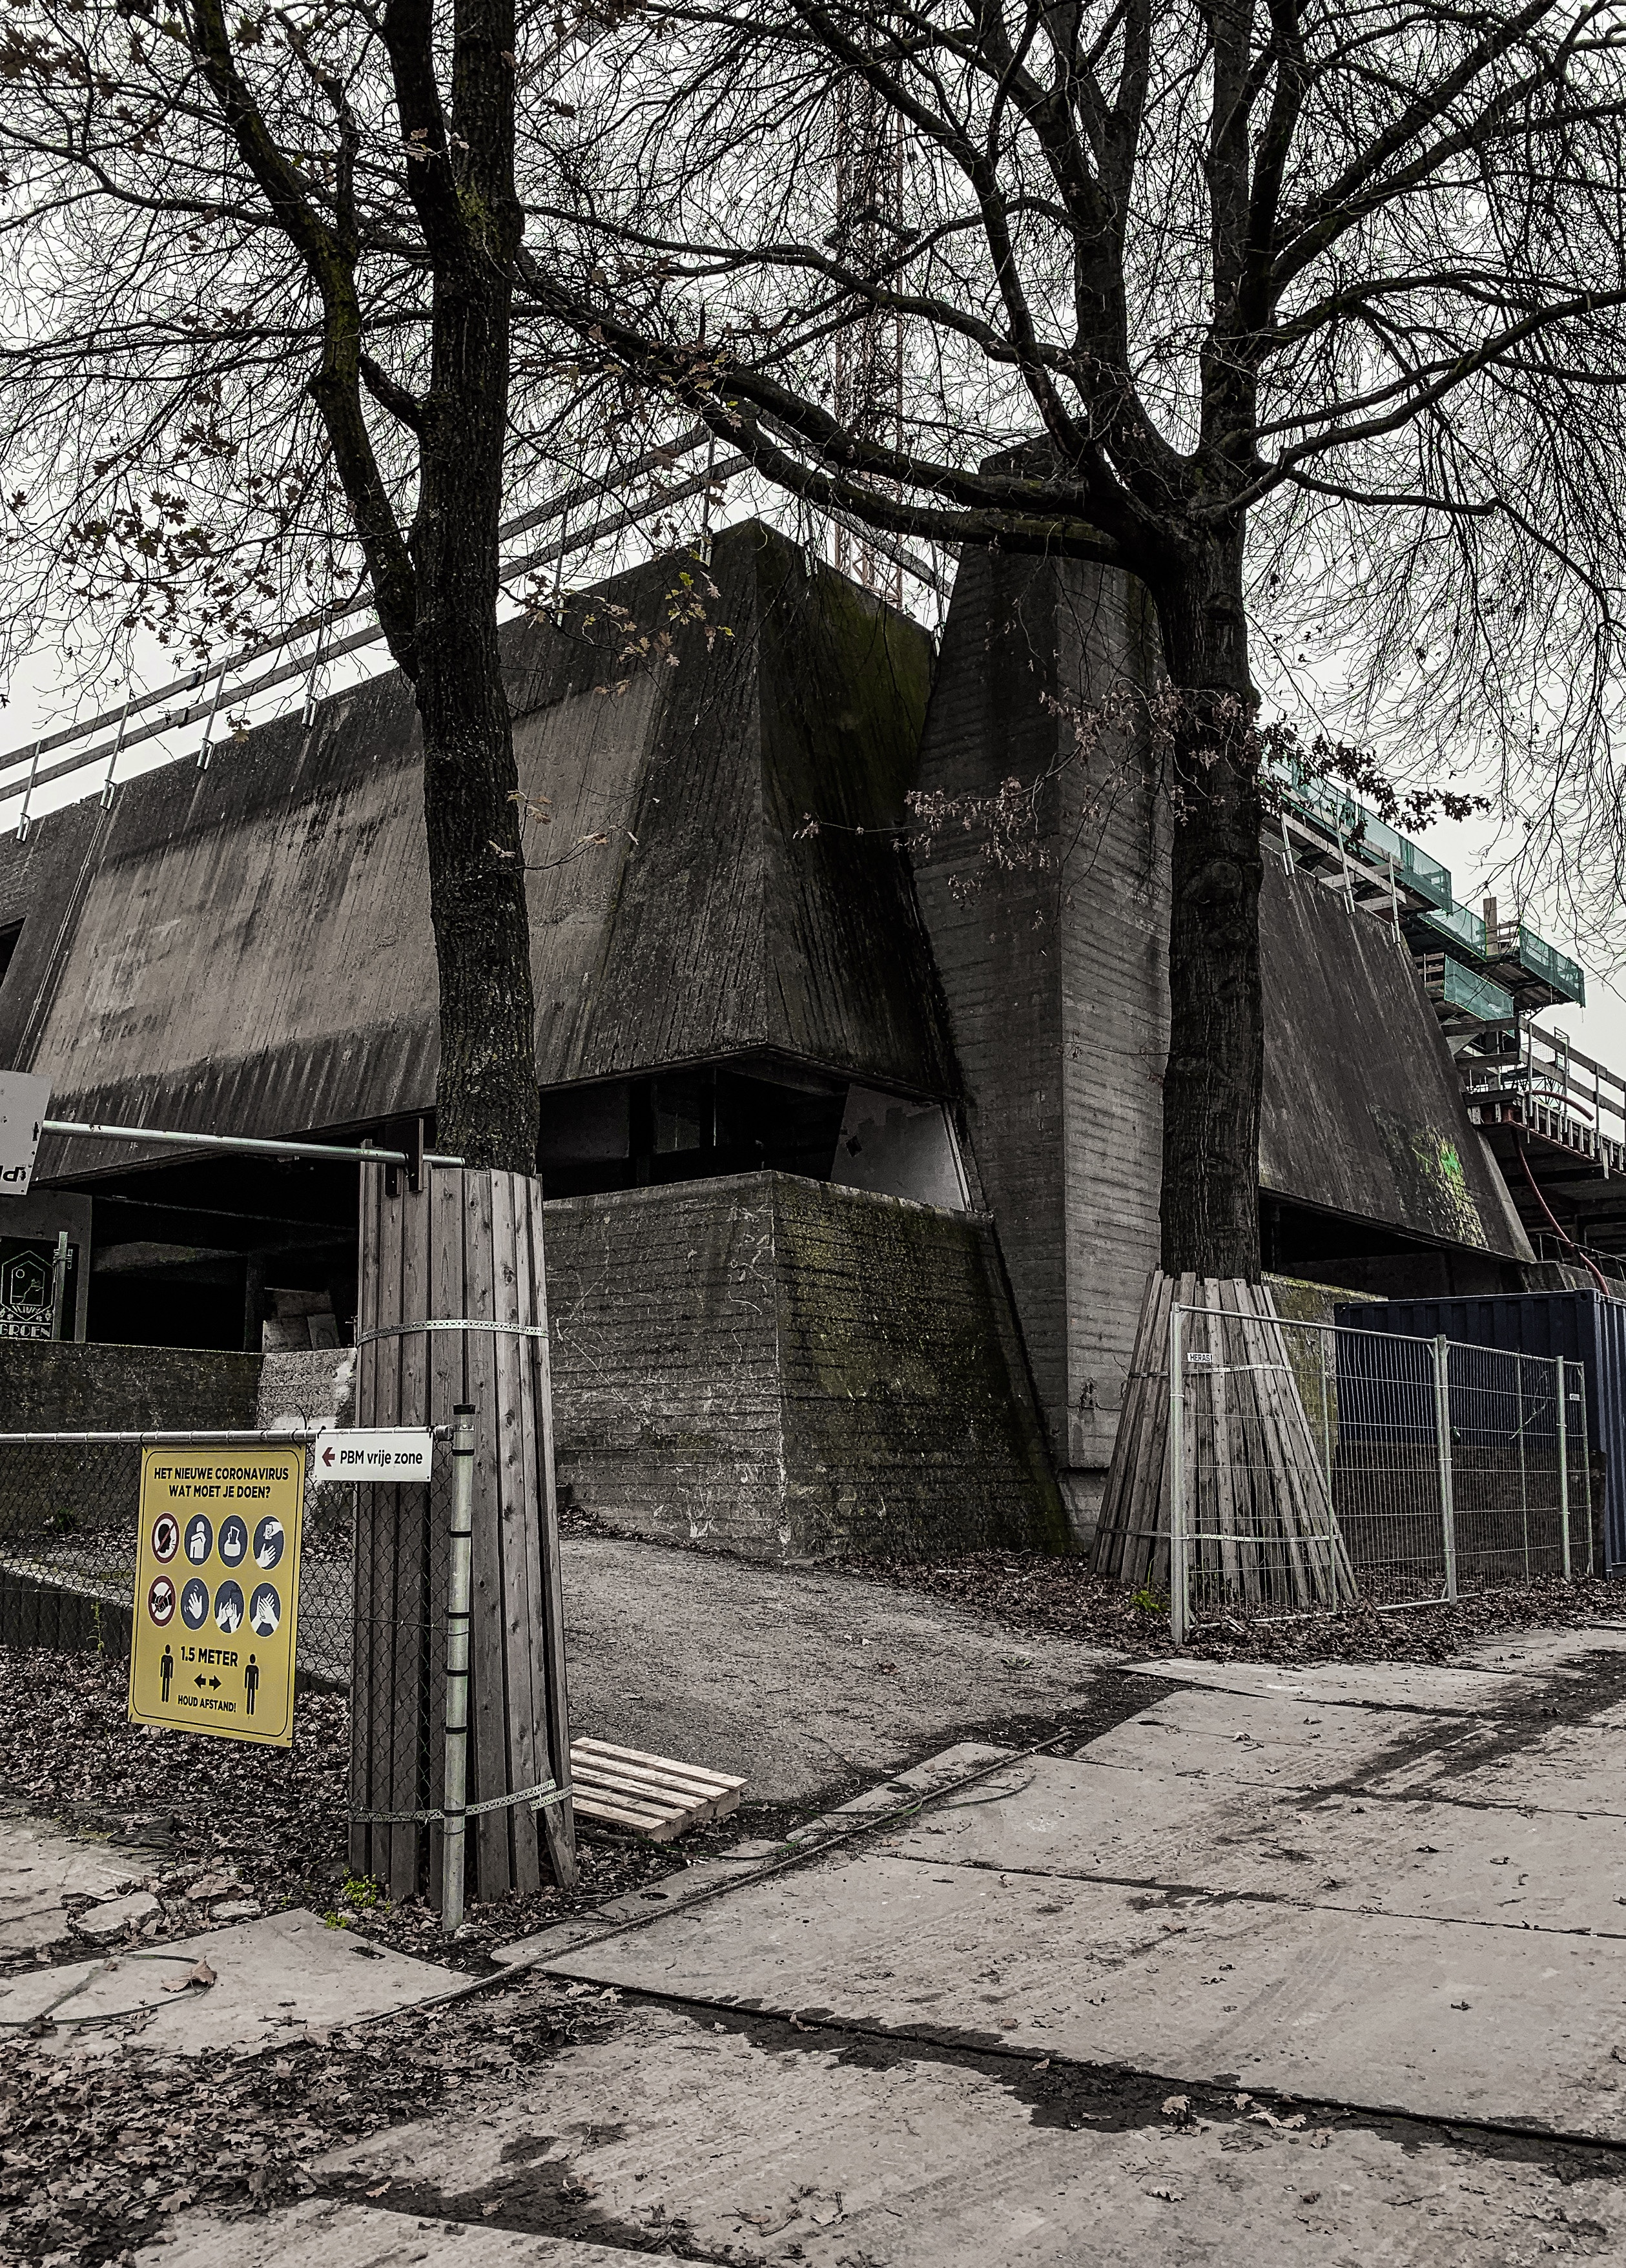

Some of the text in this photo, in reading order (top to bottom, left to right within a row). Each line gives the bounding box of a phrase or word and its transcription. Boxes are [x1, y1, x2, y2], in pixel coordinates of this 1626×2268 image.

[340, 1450, 423, 1467] PBM vrije zone
[154, 1468, 289, 1480] HET NIEUWE CORONAVIRUS
[169, 1485, 271, 1498] WAT MOET JE DOEN?
[181, 1646, 238, 1667] 1.5 METER
[178, 1695, 236, 1713] HOUD AFSTAND!
